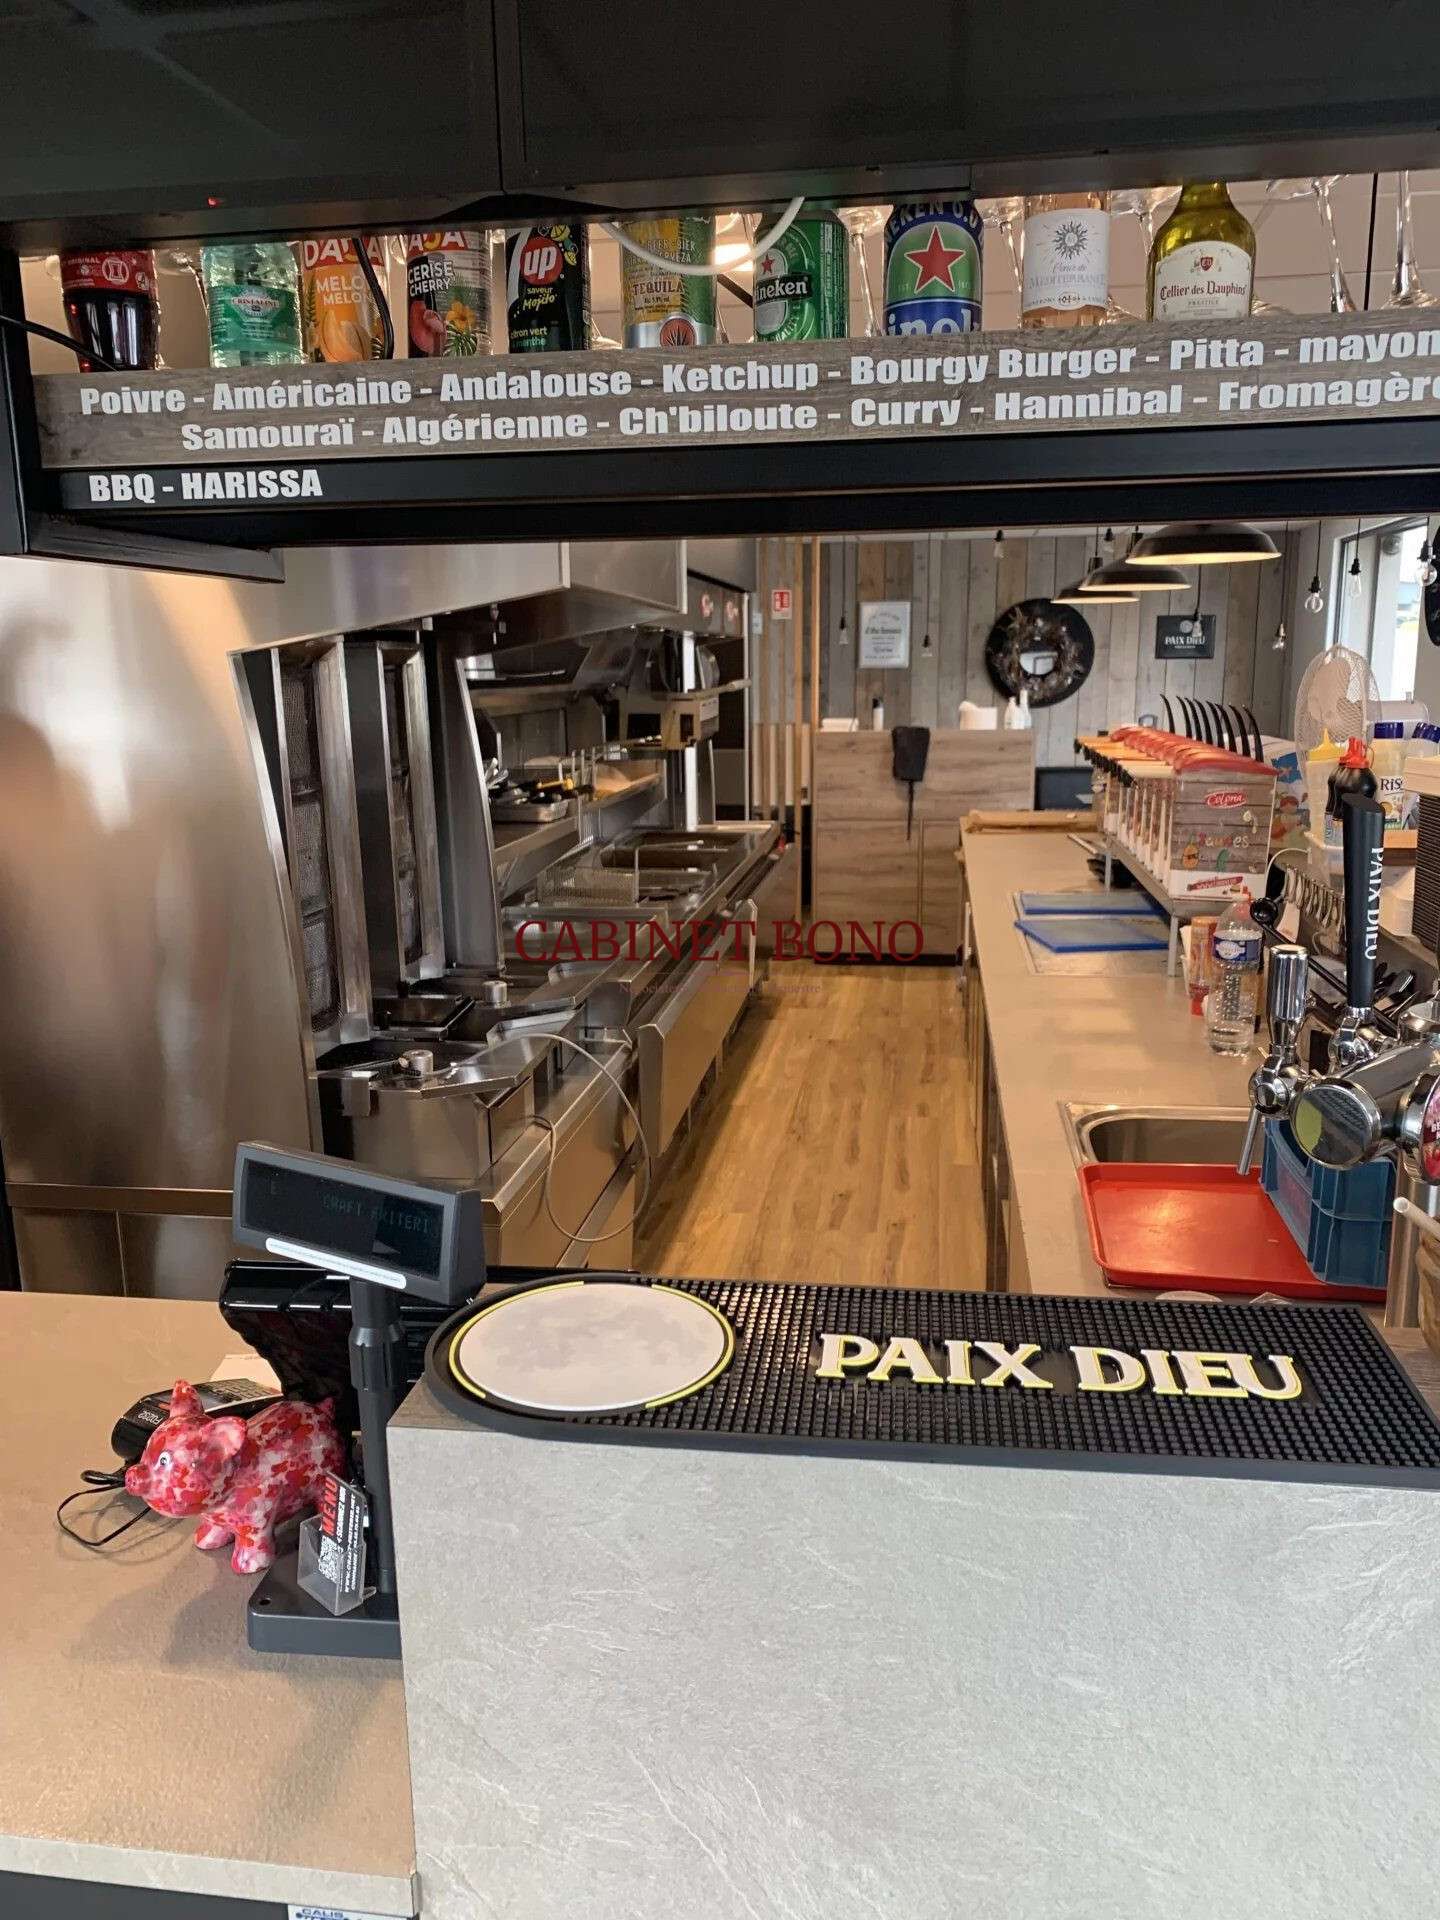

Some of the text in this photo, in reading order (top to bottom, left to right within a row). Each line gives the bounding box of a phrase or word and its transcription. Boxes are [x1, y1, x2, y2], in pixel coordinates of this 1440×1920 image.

[316, 275, 371, 293] MELO
[408, 261, 454, 285] CERISE
[409, 278, 451, 298] CHERRY
[527, 287, 554, 295] saveur
[633, 280, 685, 297] TEQUILA
[756, 278, 808, 300] ineken
[1160, 281, 1248, 301] Cellier des Dauphins
[522, 294, 558, 311] Mojito
[530, 326, 548, 337] vert
[80, 386, 186, 415] Poivre
[212, 377, 413, 412] Américaine
[439, 369, 632, 402] Andalouse
[662, 361, 819, 393] Ketchup
[850, 355, 989, 386] Bourgy
[998, 346, 1137, 379] Burger
[1169, 338, 1264, 370] Pitta
[181, 417, 355, 451] Samouraï
[382, 413, 588, 446] Algérienne
[619, 403, 818, 436] Ch'biloute
[850, 397, 961, 427] Curry
[994, 384, 1183, 421] Hannibal
[89, 473, 156, 504] BBQ
[181, 469, 323, 500] HARISSA
[1364, 847, 1385, 961] PAIX DIEU
[815, 1332, 1303, 1401] PAIX DIEU
[321, 1476, 338, 1537] MENU
